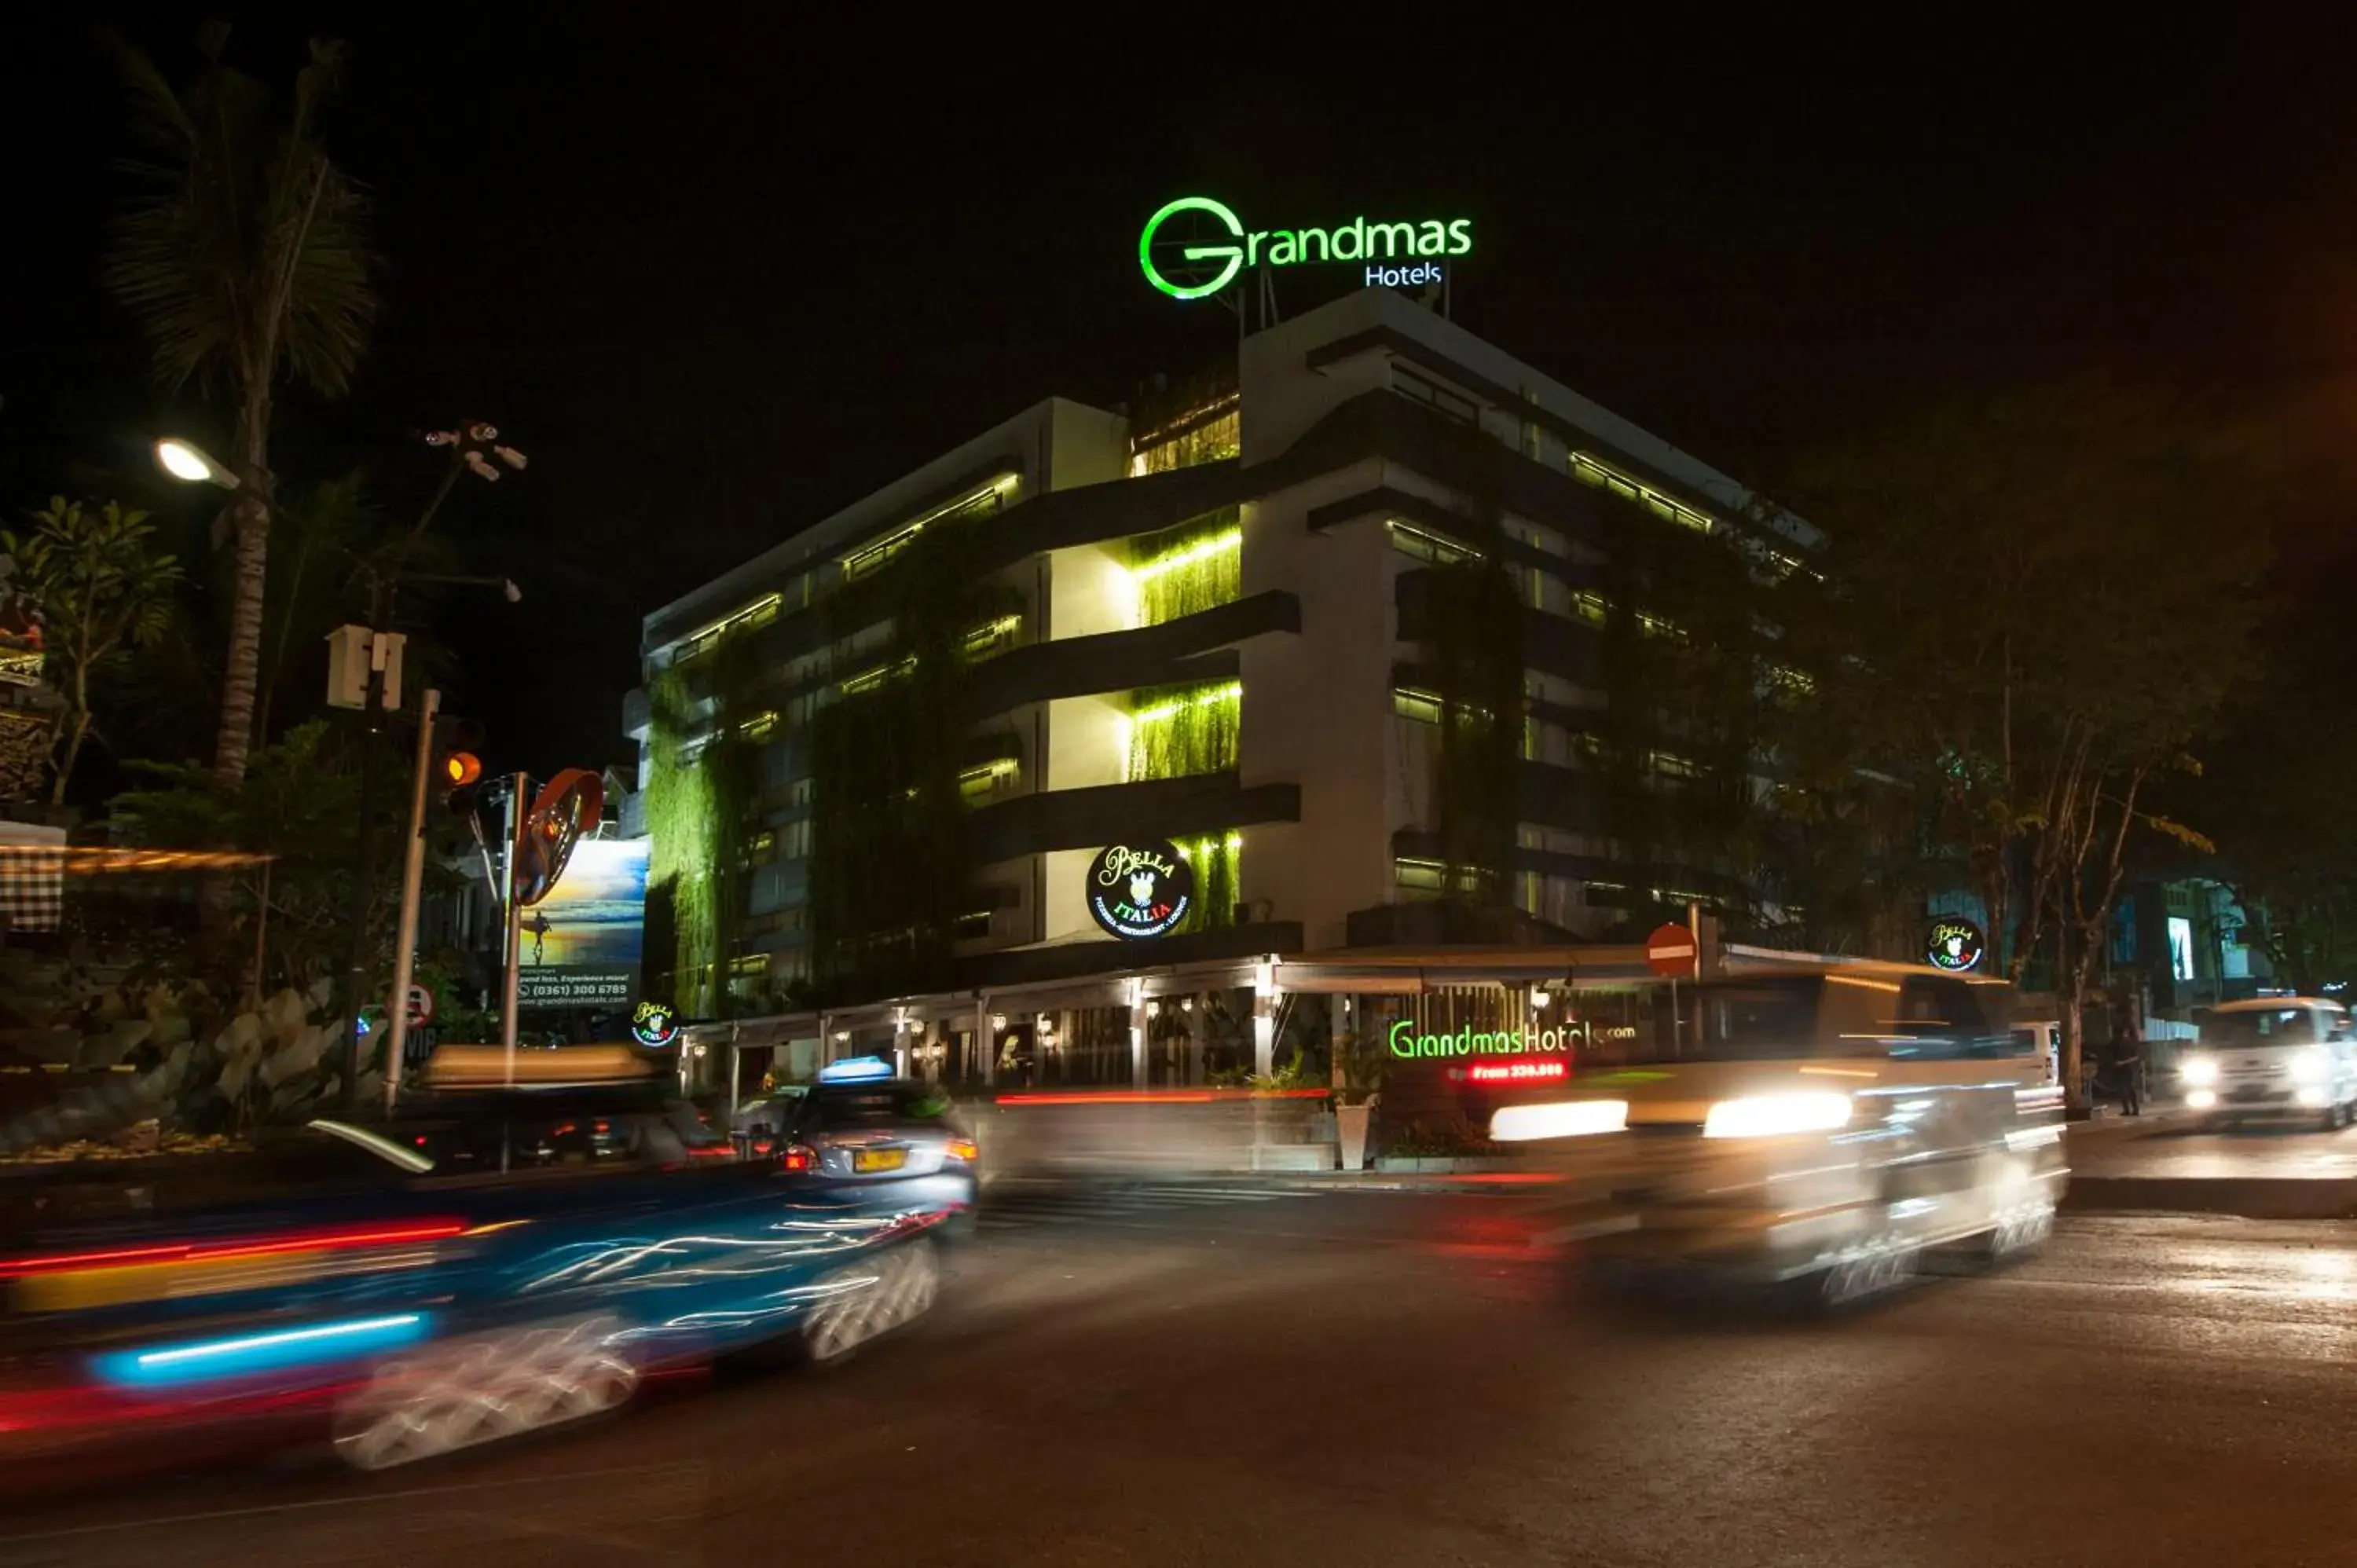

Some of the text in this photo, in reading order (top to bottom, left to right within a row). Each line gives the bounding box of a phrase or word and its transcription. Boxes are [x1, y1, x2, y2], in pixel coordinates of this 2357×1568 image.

[1139, 196, 1472, 299] Grandmas
[1365, 262, 1442, 288] Hotels
[1113, 901, 1172, 922] ITALIA
[533, 984, 570, 997] (0361)
[598, 984, 627, 995] 6789
